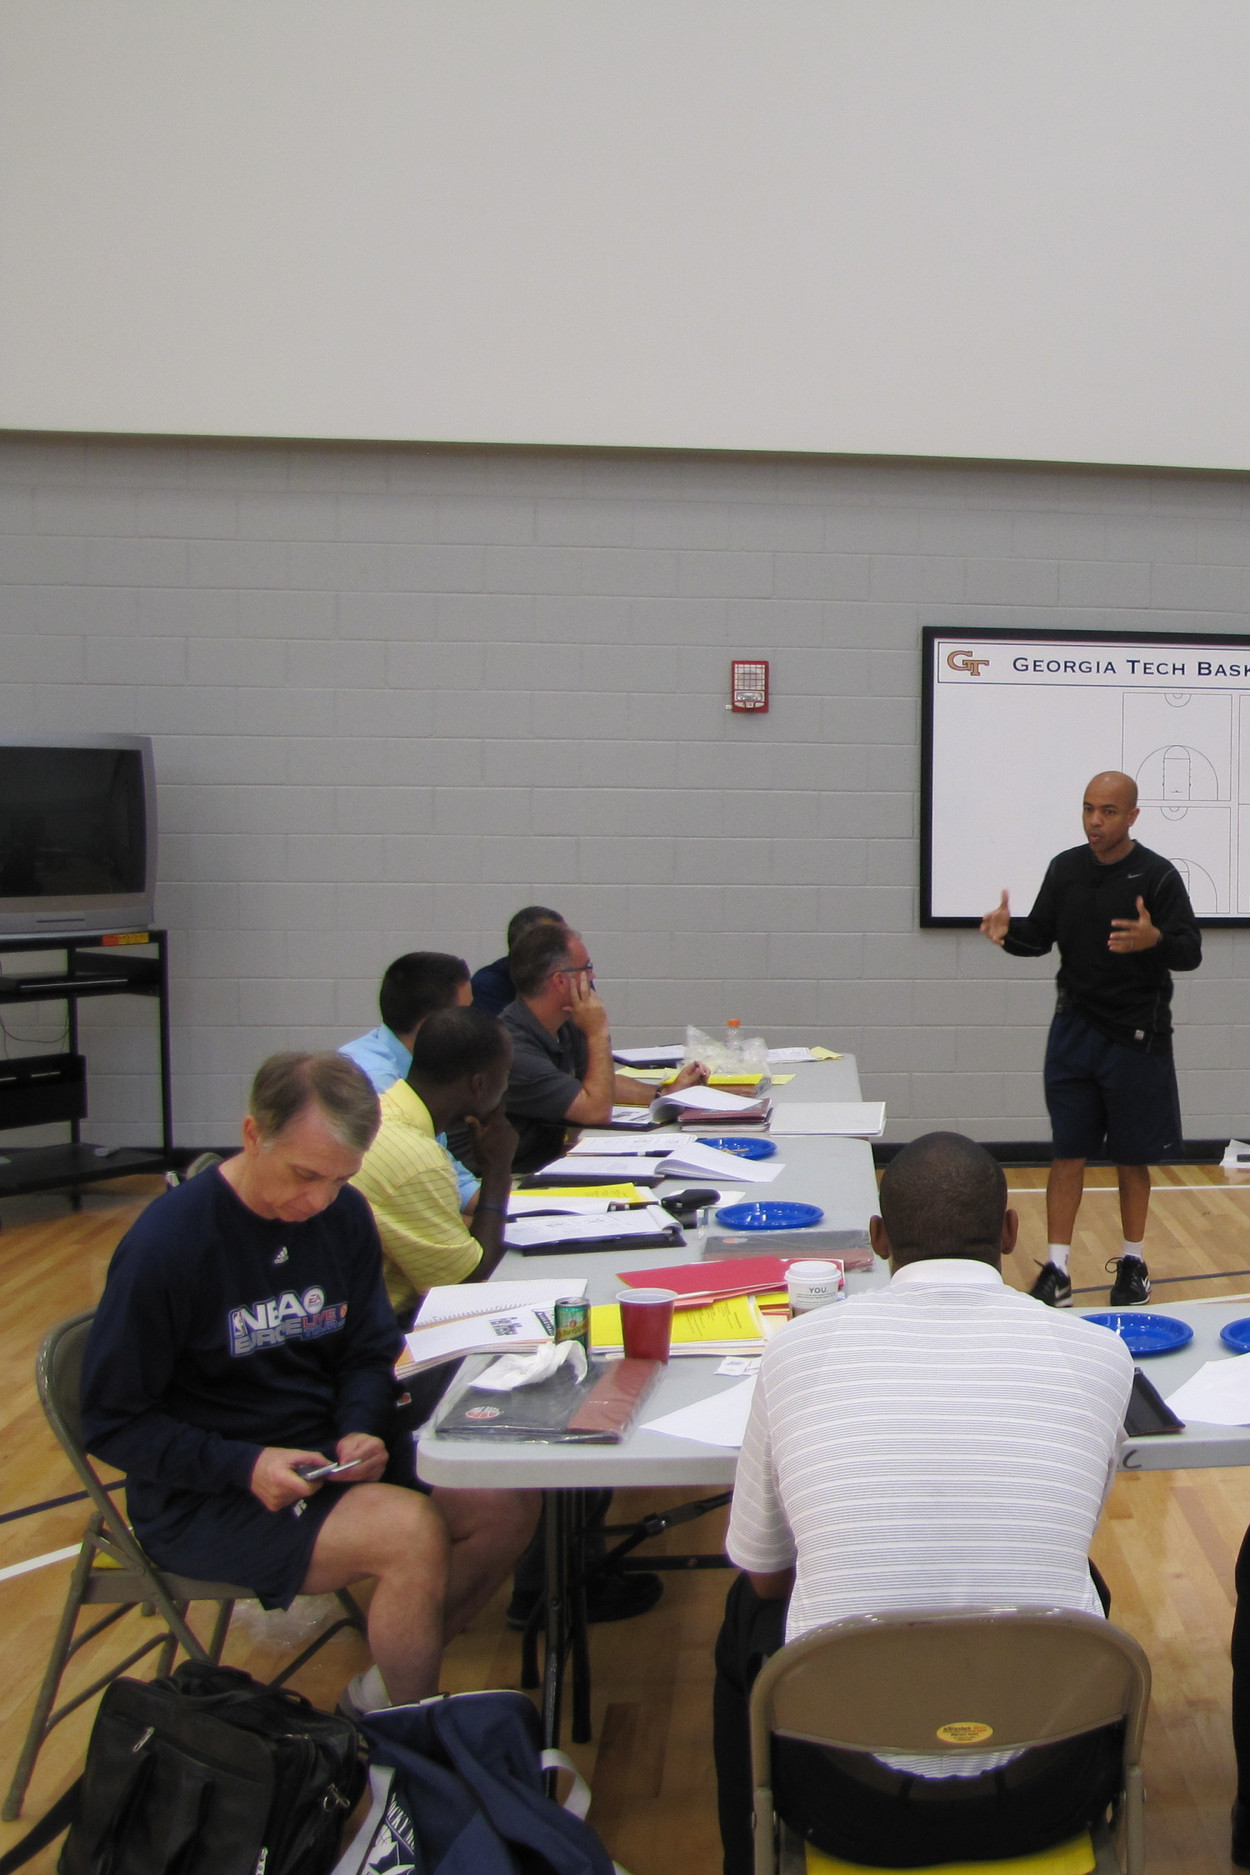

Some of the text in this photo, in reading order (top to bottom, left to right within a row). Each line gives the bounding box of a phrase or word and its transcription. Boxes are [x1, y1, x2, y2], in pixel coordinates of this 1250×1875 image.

[947, 650, 989, 676] GT
[1013, 657, 1116, 674] GEORGIA
[1126, 659, 1186, 676] TECH
[808, 1286, 827, 1294] YOU
